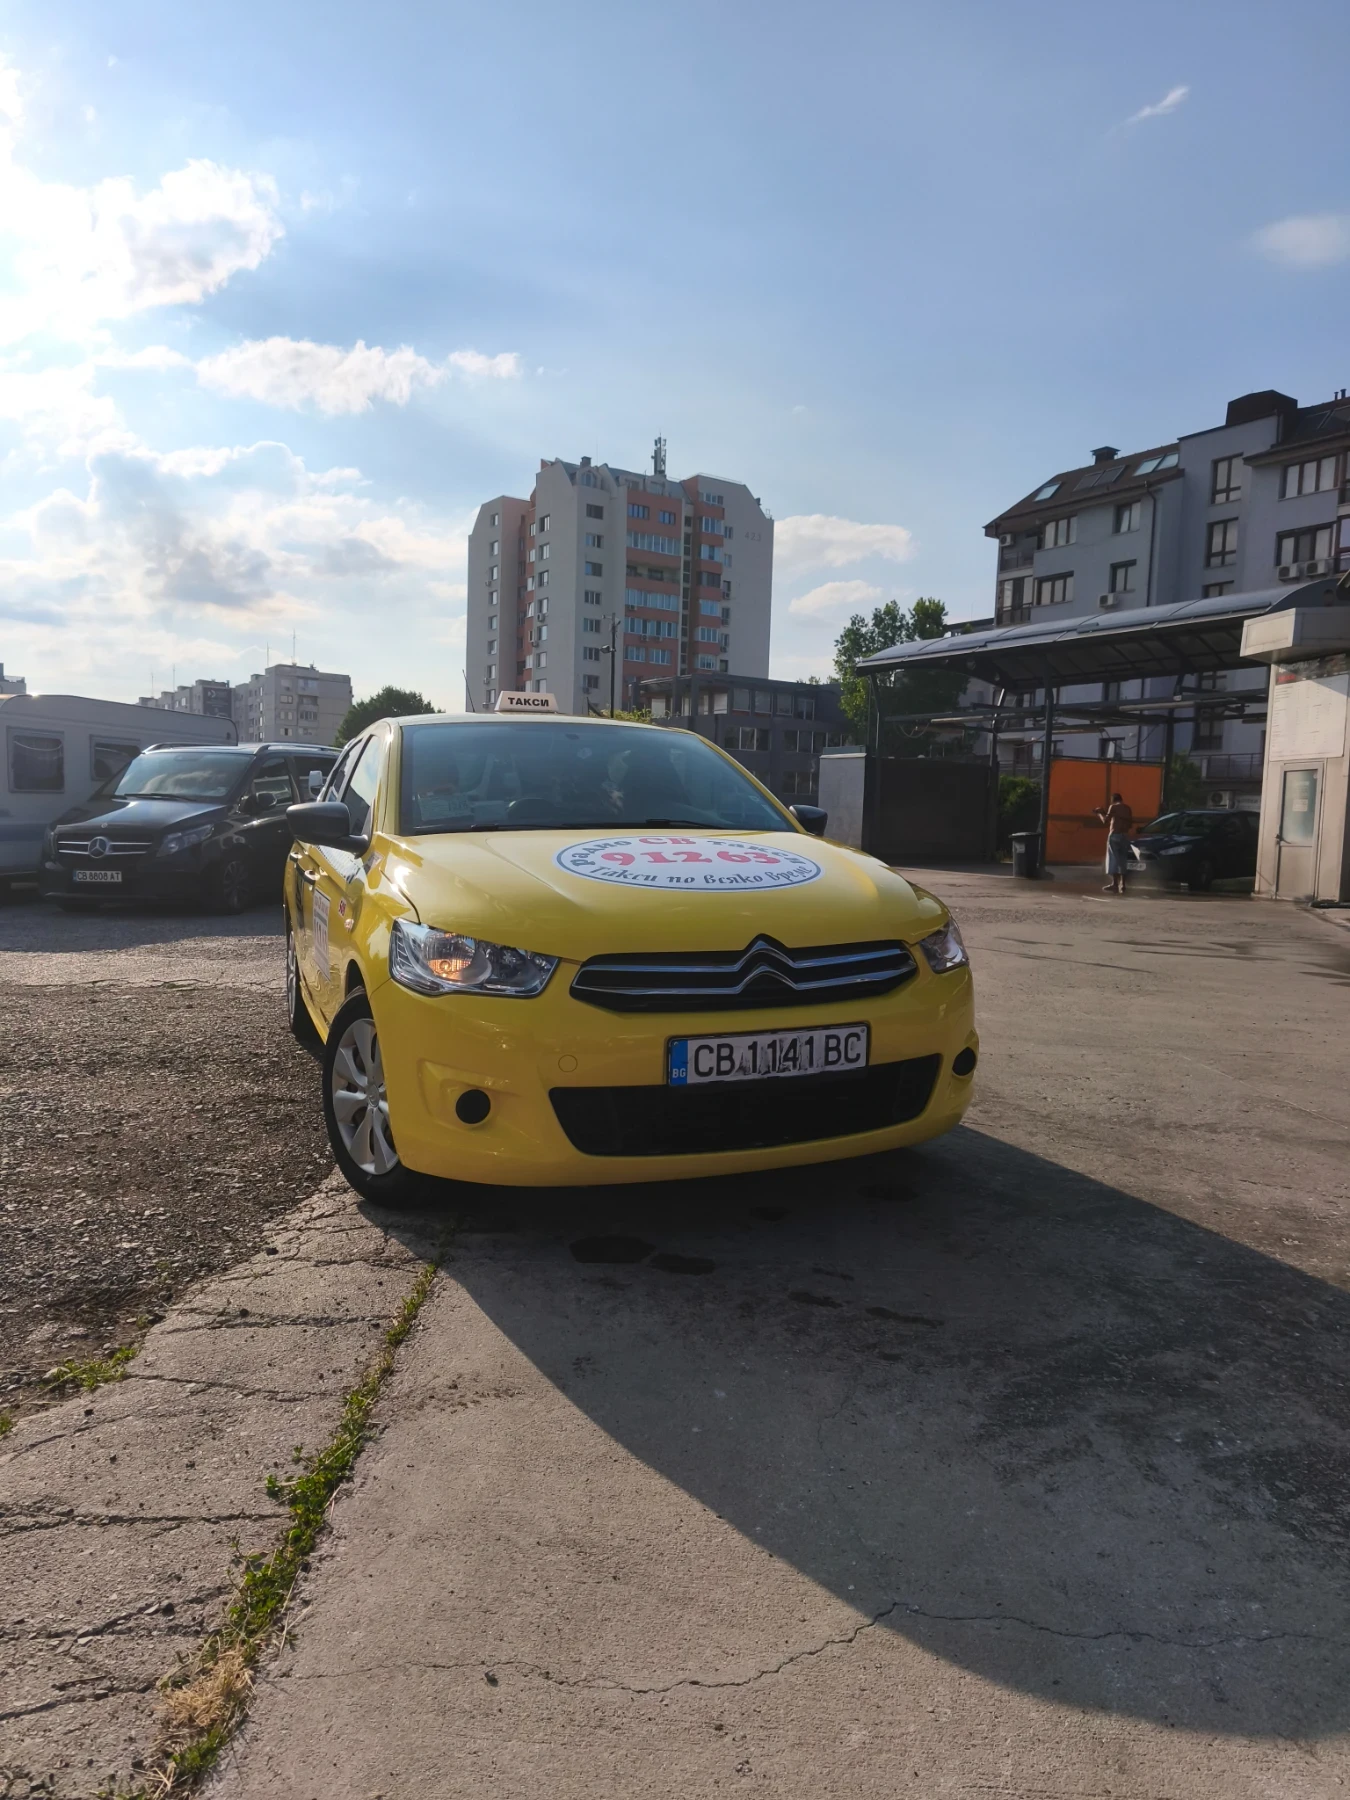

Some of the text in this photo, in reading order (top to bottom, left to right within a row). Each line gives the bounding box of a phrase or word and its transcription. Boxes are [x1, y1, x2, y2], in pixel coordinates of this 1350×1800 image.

[508, 697, 549, 707] ТАКСИ
[666, 874, 695, 885] по
[672, 1068, 687, 1078] BG
